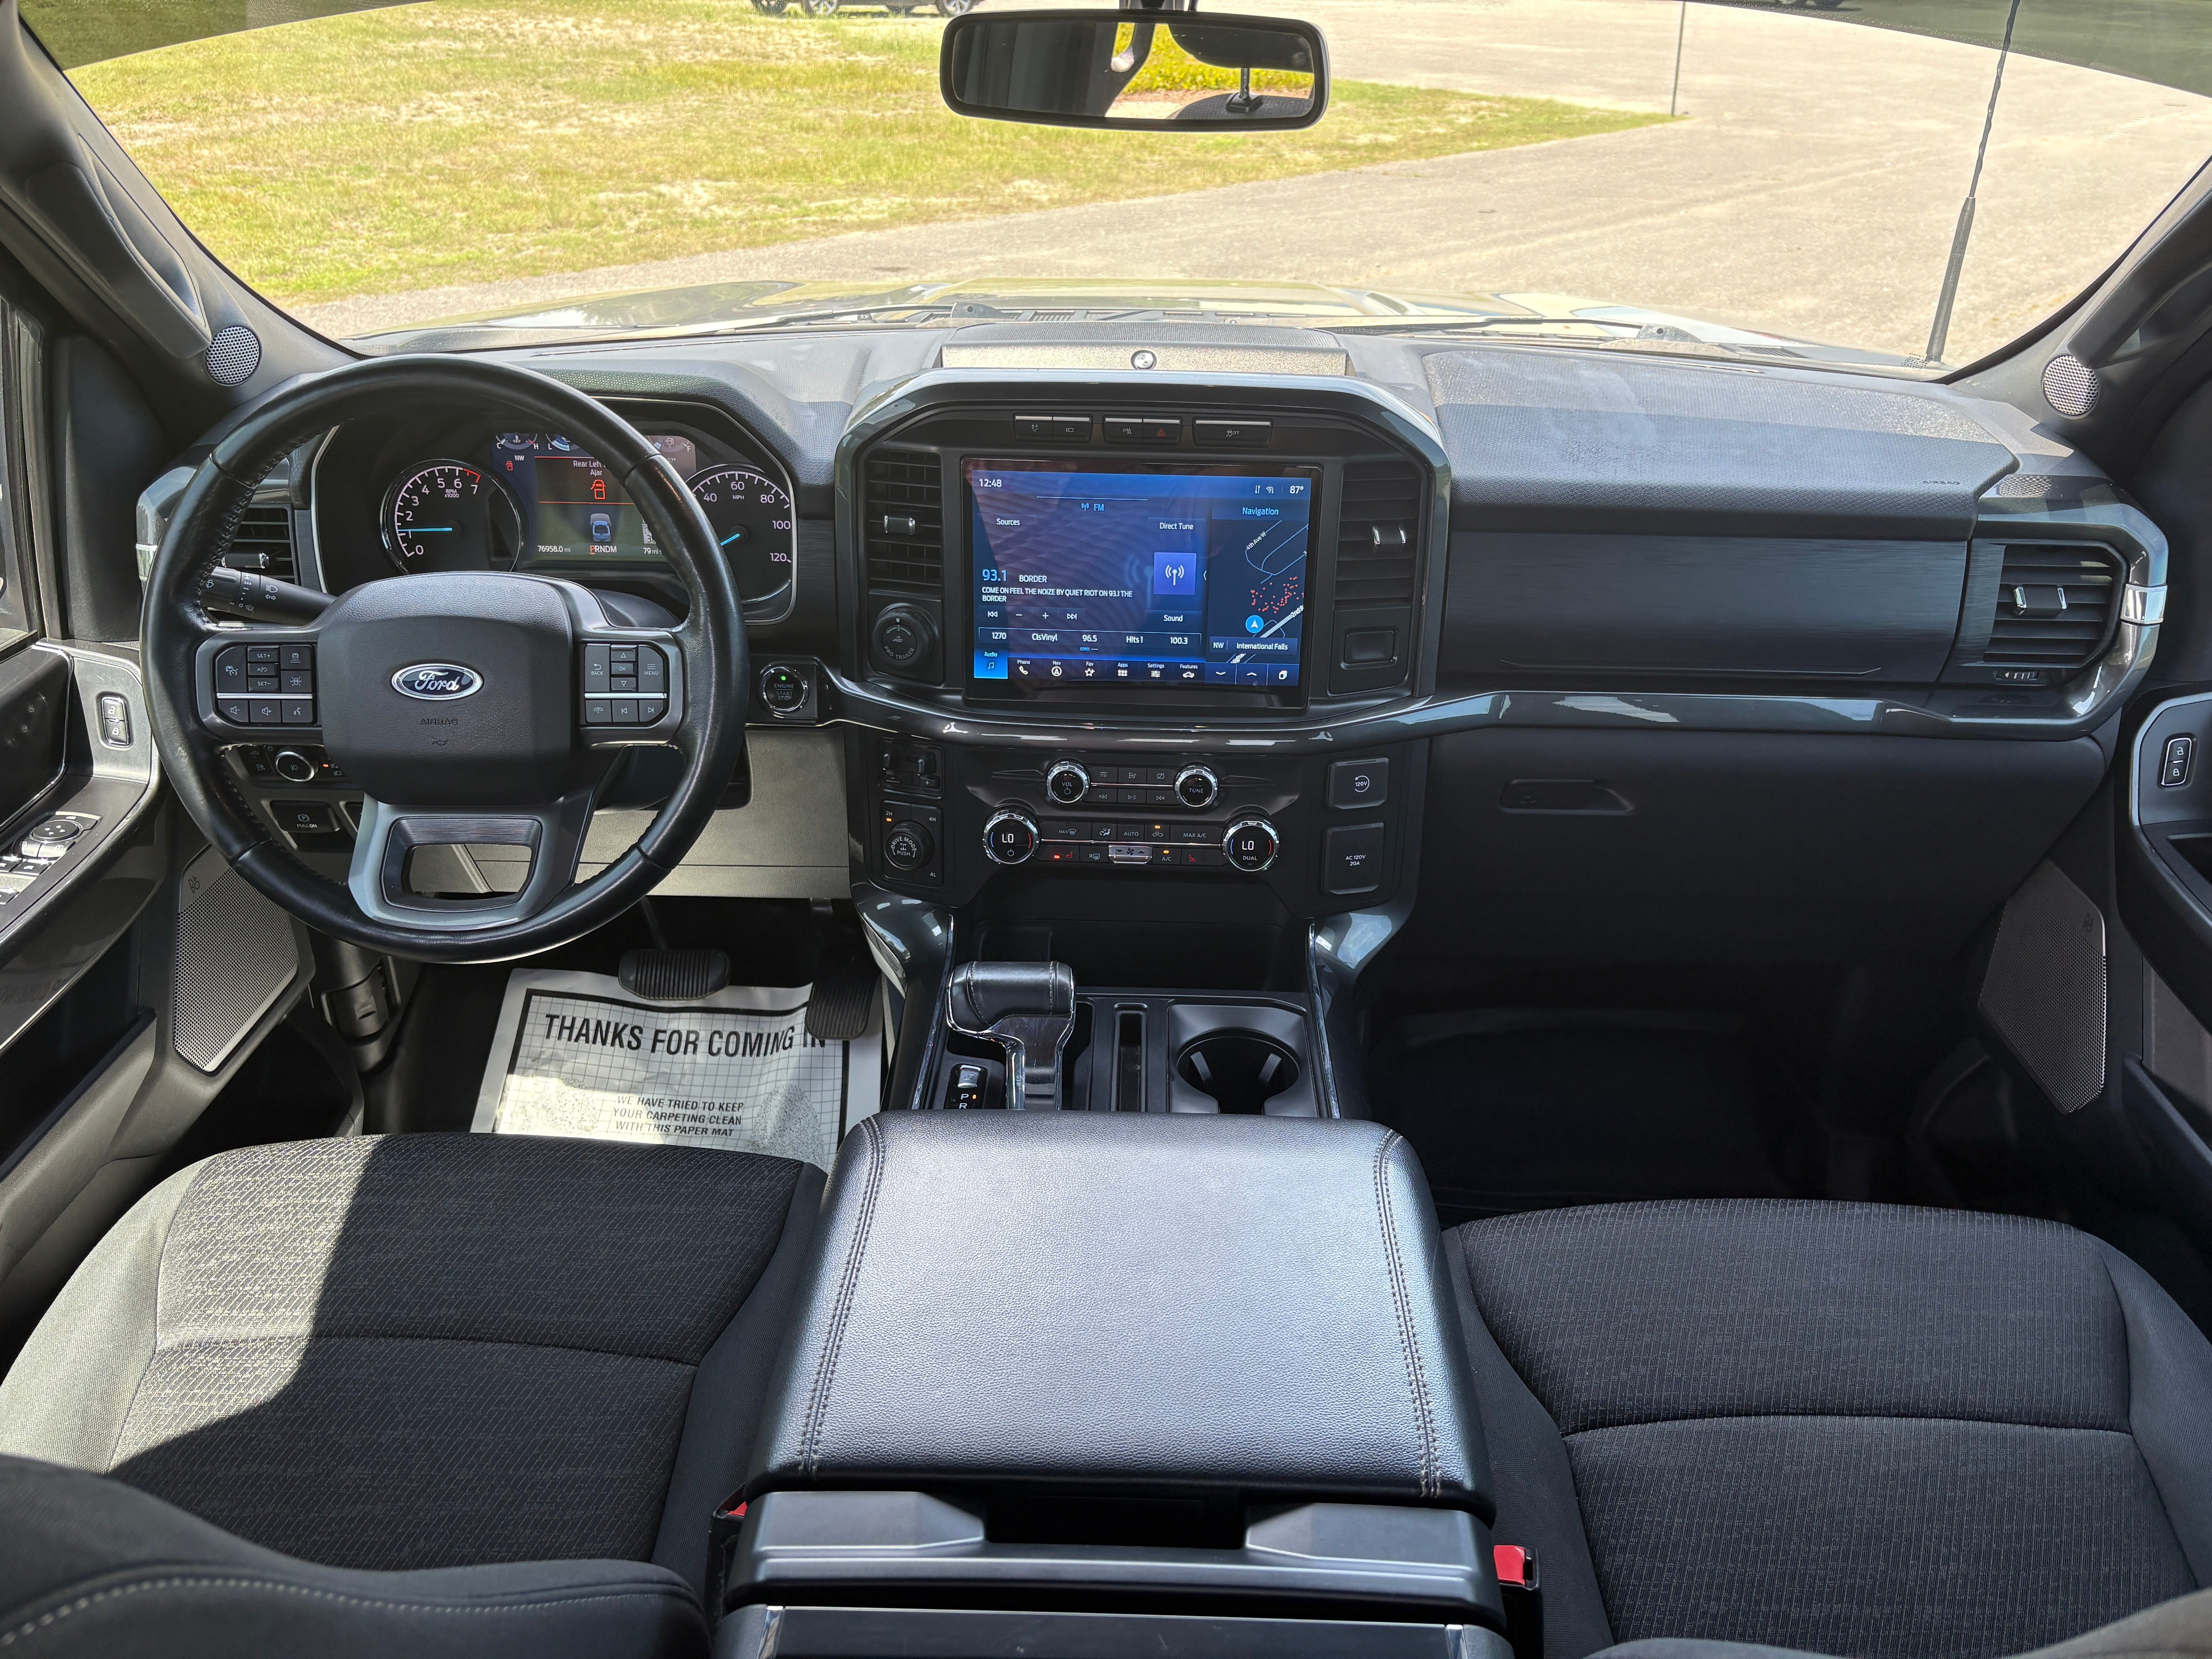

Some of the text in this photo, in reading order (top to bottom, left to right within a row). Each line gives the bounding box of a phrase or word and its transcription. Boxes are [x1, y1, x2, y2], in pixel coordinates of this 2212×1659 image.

[438, 478, 445, 488] 5
[454, 478, 462, 488] 6
[731, 481, 745, 490] 60
[979, 479, 1002, 488] 12:48
[422, 485, 430, 495] 4
[471, 485, 479, 494] 7
[411, 496, 419, 506] 3
[703, 493, 717, 502] 40
[760, 495, 775, 503] 80
[405, 511, 413, 521] 2
[1242, 507, 1279, 516] Navigation
[772, 520, 791, 529] 100
[1246, 542, 1255, 550] 4th
[1253, 536, 1262, 545] Ave
[416, 545, 424, 555] 0
[770, 553, 787, 562] 120
[982, 569, 1007, 581] 93.1
[1032, 634, 1058, 642] ClsVinyl
[884, 646, 915, 660] PRO TRAILER
[414, 670, 460, 691] Ford
[1002, 834, 1014, 843] LO
[891, 836, 917, 852] DRIVE MODE
[1242, 841, 1254, 851] LO
[546, 1014, 643, 1051] THANKS
[651, 1029, 700, 1055] FOR
[708, 1025, 795, 1058] COMING
[617, 1095, 744, 1112] WE HAVE TRIED TO KEEP
[613, 1108, 742, 1125] YOUR CARPETING CLEAN
[616, 1121, 735, 1137] WITH THIS PAPER MAT
